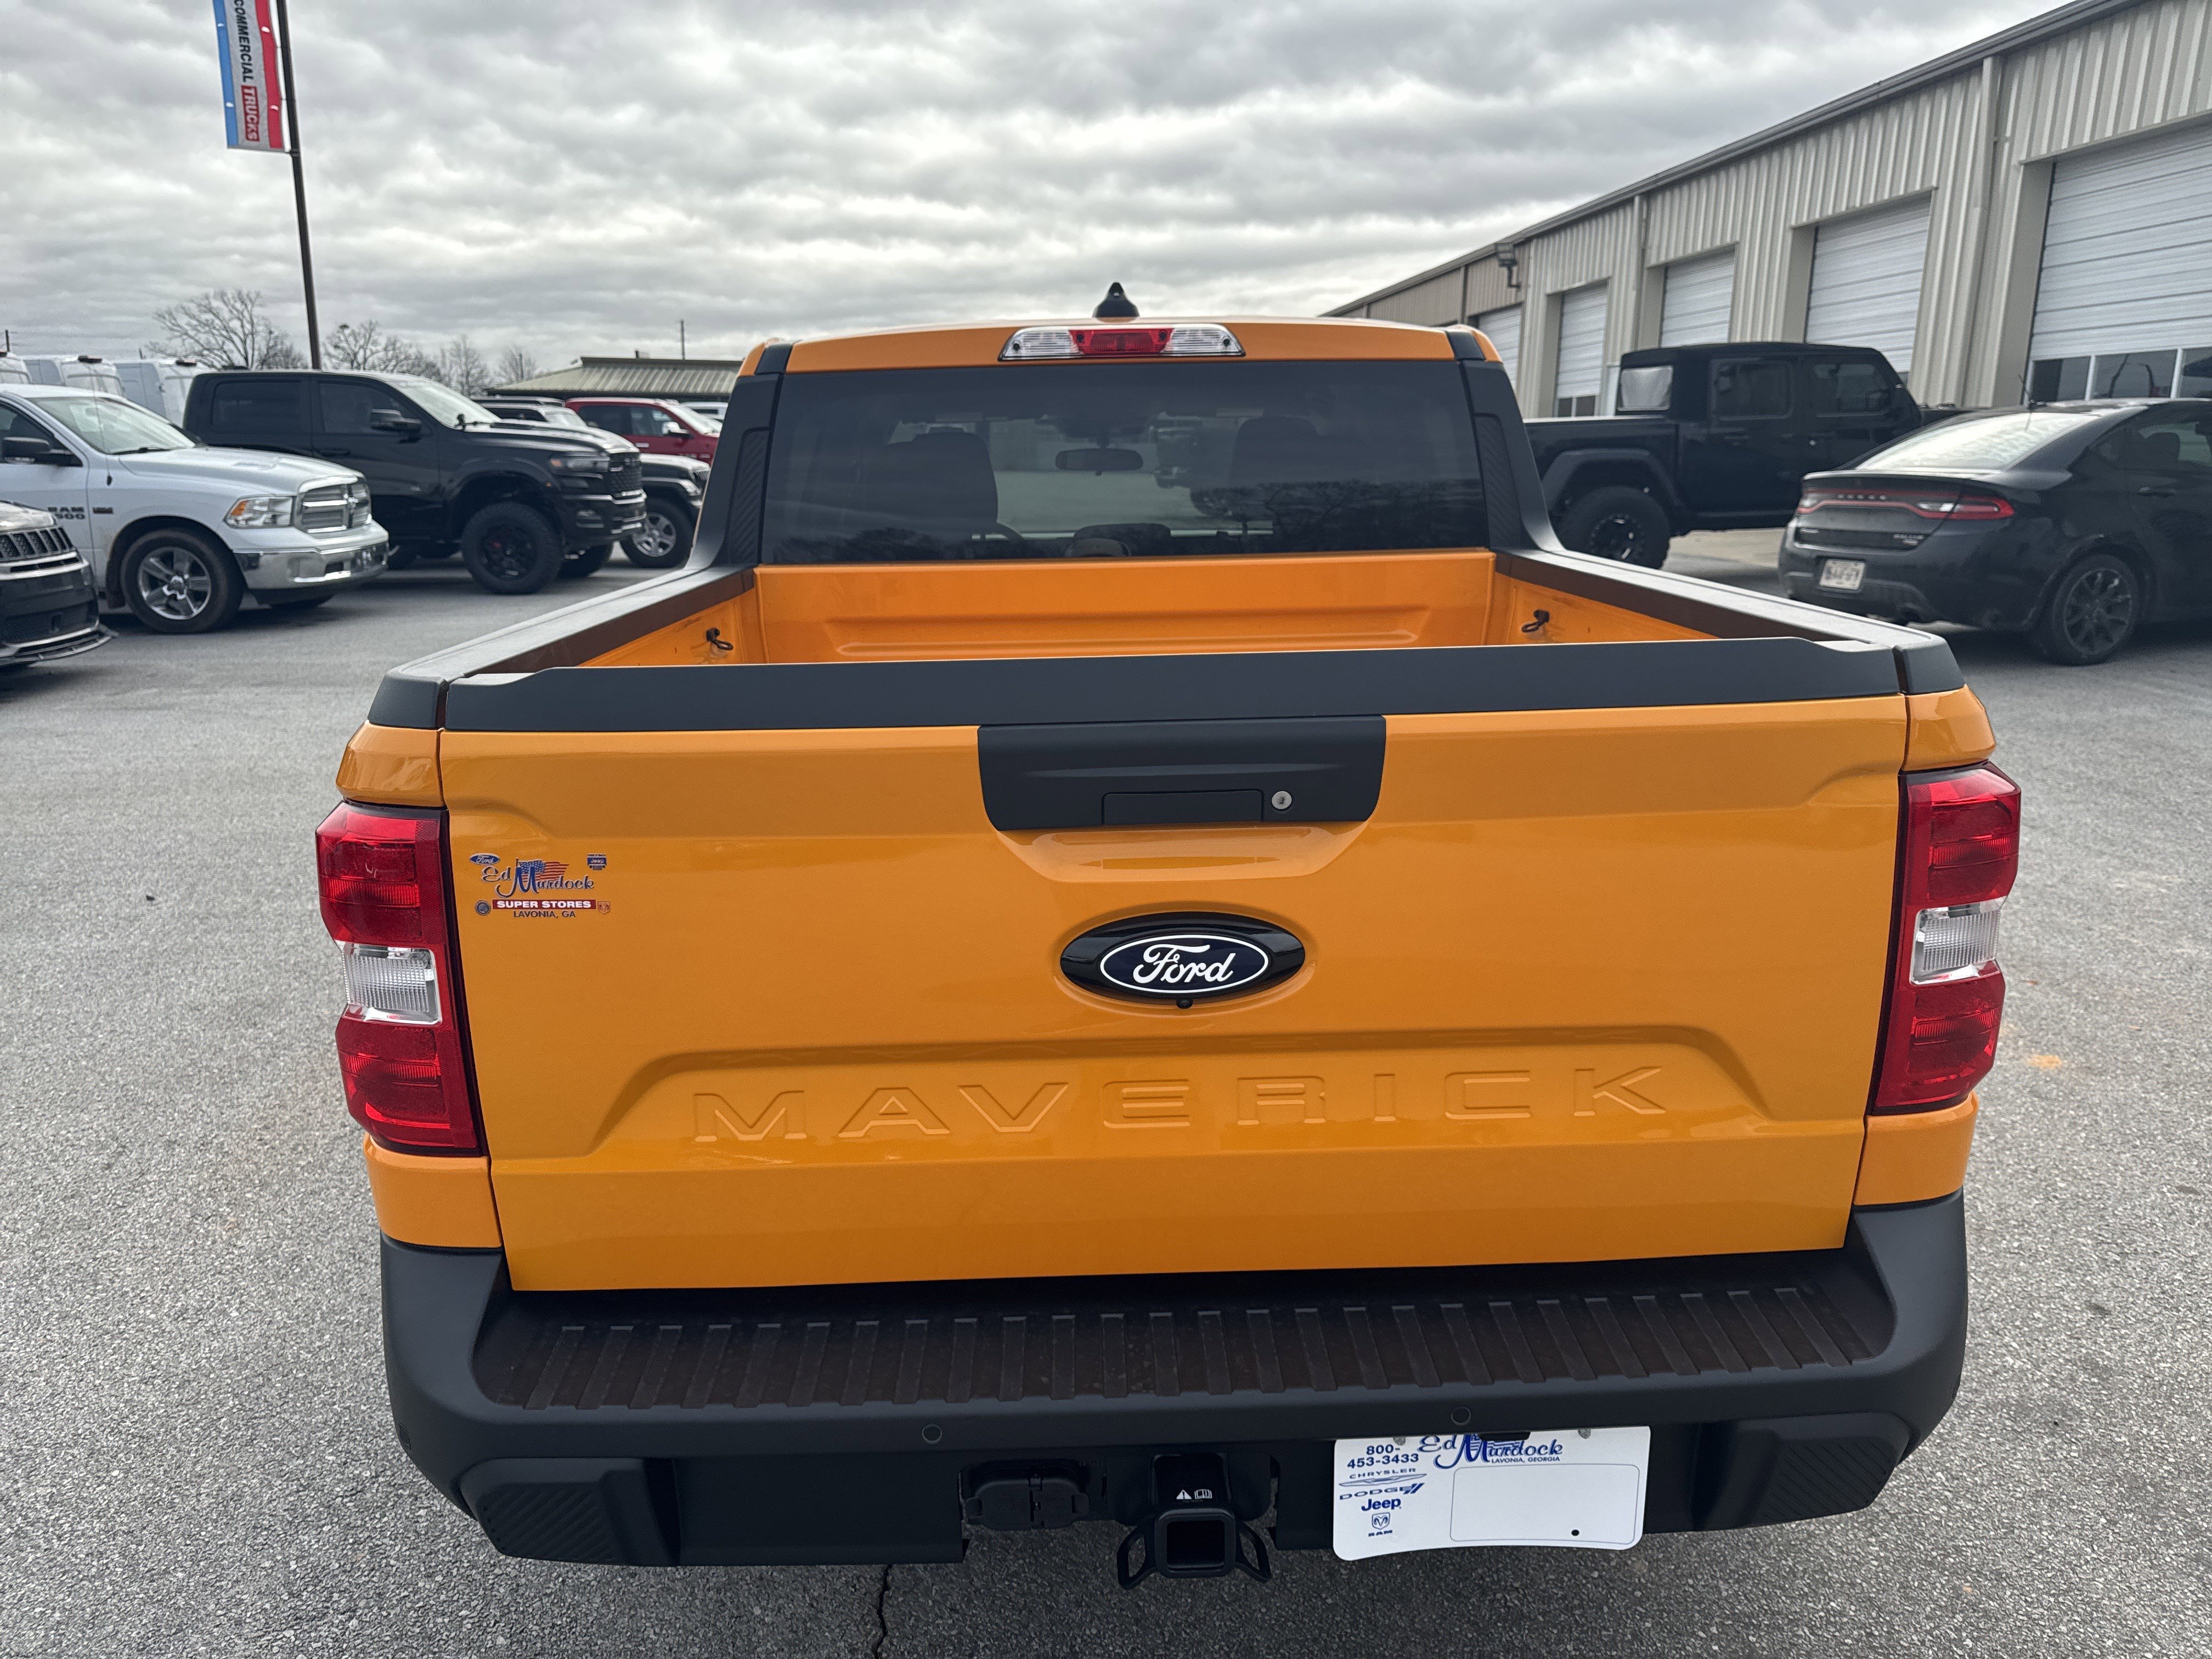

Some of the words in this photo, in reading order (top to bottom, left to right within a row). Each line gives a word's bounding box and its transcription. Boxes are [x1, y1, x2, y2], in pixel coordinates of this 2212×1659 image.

[234, 0, 253, 83] COMMERCIAL
[244, 88, 258, 141] TRUCKS
[476, 854, 494, 864] Ford
[482, 866, 512, 882] Ed
[495, 865, 595, 898] Murdock
[496, 900, 538, 909] SUPER
[1133, 944, 1236, 983] Ford
[693, 1066, 1667, 1142] MAVERICK
[1366, 1444, 1400, 1455] 800-
[1417, 1435, 1457, 1452] Ed
[1433, 1434, 1563, 1469] Murdock
[1347, 1453, 1419, 1469] 453-3433
[1350, 1468, 1416, 1479] CHRYSLER
[1340, 1486, 1413, 1500] DODGE
[1361, 1498, 1401, 1511] Jeep
